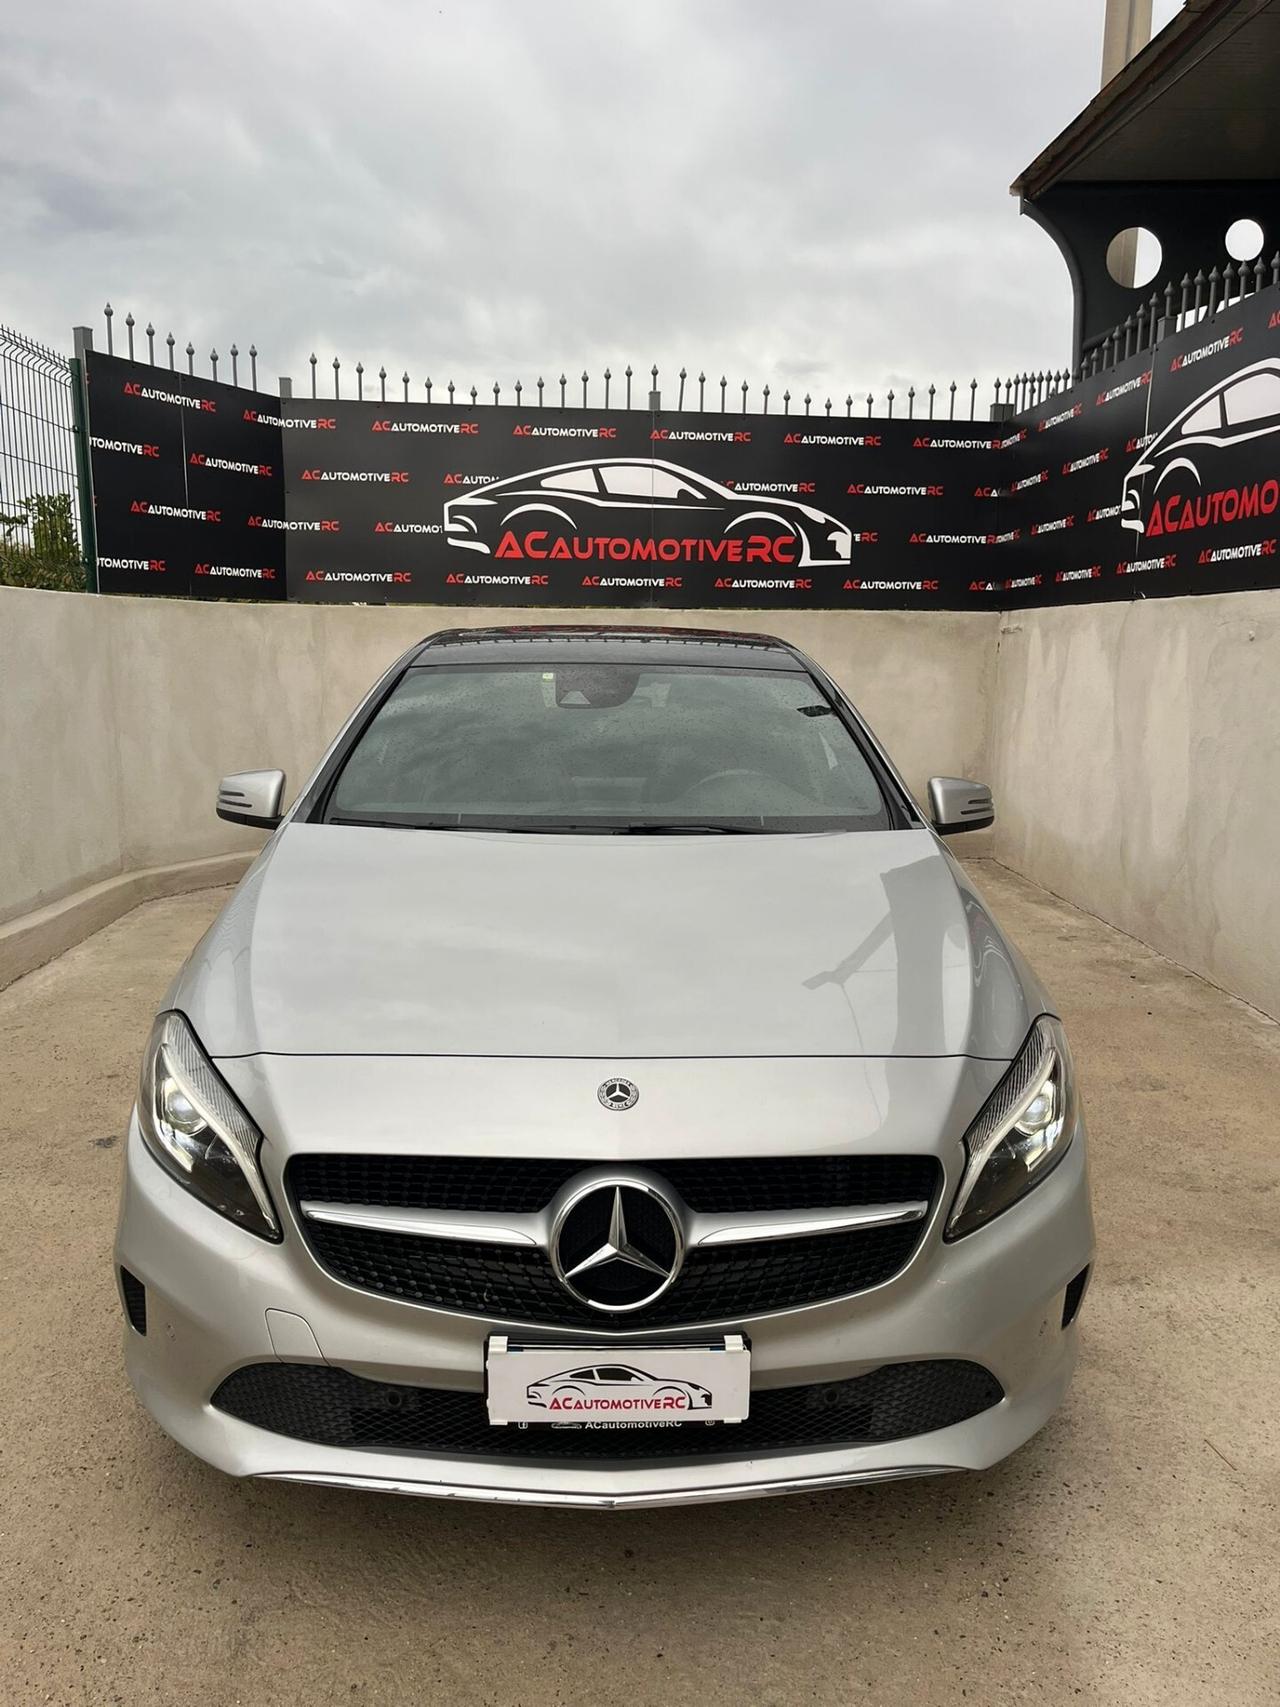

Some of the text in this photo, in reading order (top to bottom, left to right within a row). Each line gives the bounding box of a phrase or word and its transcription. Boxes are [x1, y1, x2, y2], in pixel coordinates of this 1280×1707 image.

[1169, 326, 1244, 372] ACAUTOMOTIVERC
[1096, 369, 1153, 406] ACAUTOMOTIVERC
[123, 381, 217, 412] ACAUTOMOTIVERC
[243, 410, 335, 429] ACAUTOMOTIVERC
[371, 420, 479, 435] ACAUTOMOTIVERC
[512, 424, 617, 439] ACAUTOMOTIVERC
[650, 428, 751, 443] ACAUTOMOTIVERC
[784, 433, 880, 446] ACAUTOMOTIVERC
[189, 452, 273, 477] ACAUTOMOTIVERC
[300, 469, 409, 484] ACAUTOMOTIVERC
[847, 484, 943, 496] ACAUTOMOTIVERC
[130, 502, 220, 523] ACAUTOMOTIVERC
[247, 517, 340, 532] ACAUTOMOTIVERC
[494, 530, 796, 563] ACAUTOMOTIVERC
[1198, 539, 1277, 565] ACAUTOMOTIVERC
[195, 564, 274, 580] ACAUTOMOTIVERC
[1116, 554, 1177, 576] ACAUTOMOTIVERC
[305, 570, 411, 583] ACAUTOMOTIVERC
[445, 573, 548, 586] ACAUTOMOTIVERC
[582, 576, 682, 589] ACAUTOMOTIVERC
[714, 577, 811, 590] ACAUTOMOTIVERC
[842, 580, 938, 591] ACAUTOMOTIVERC
[549, 1396, 686, 1411] ACAUTOMOTIVERC
